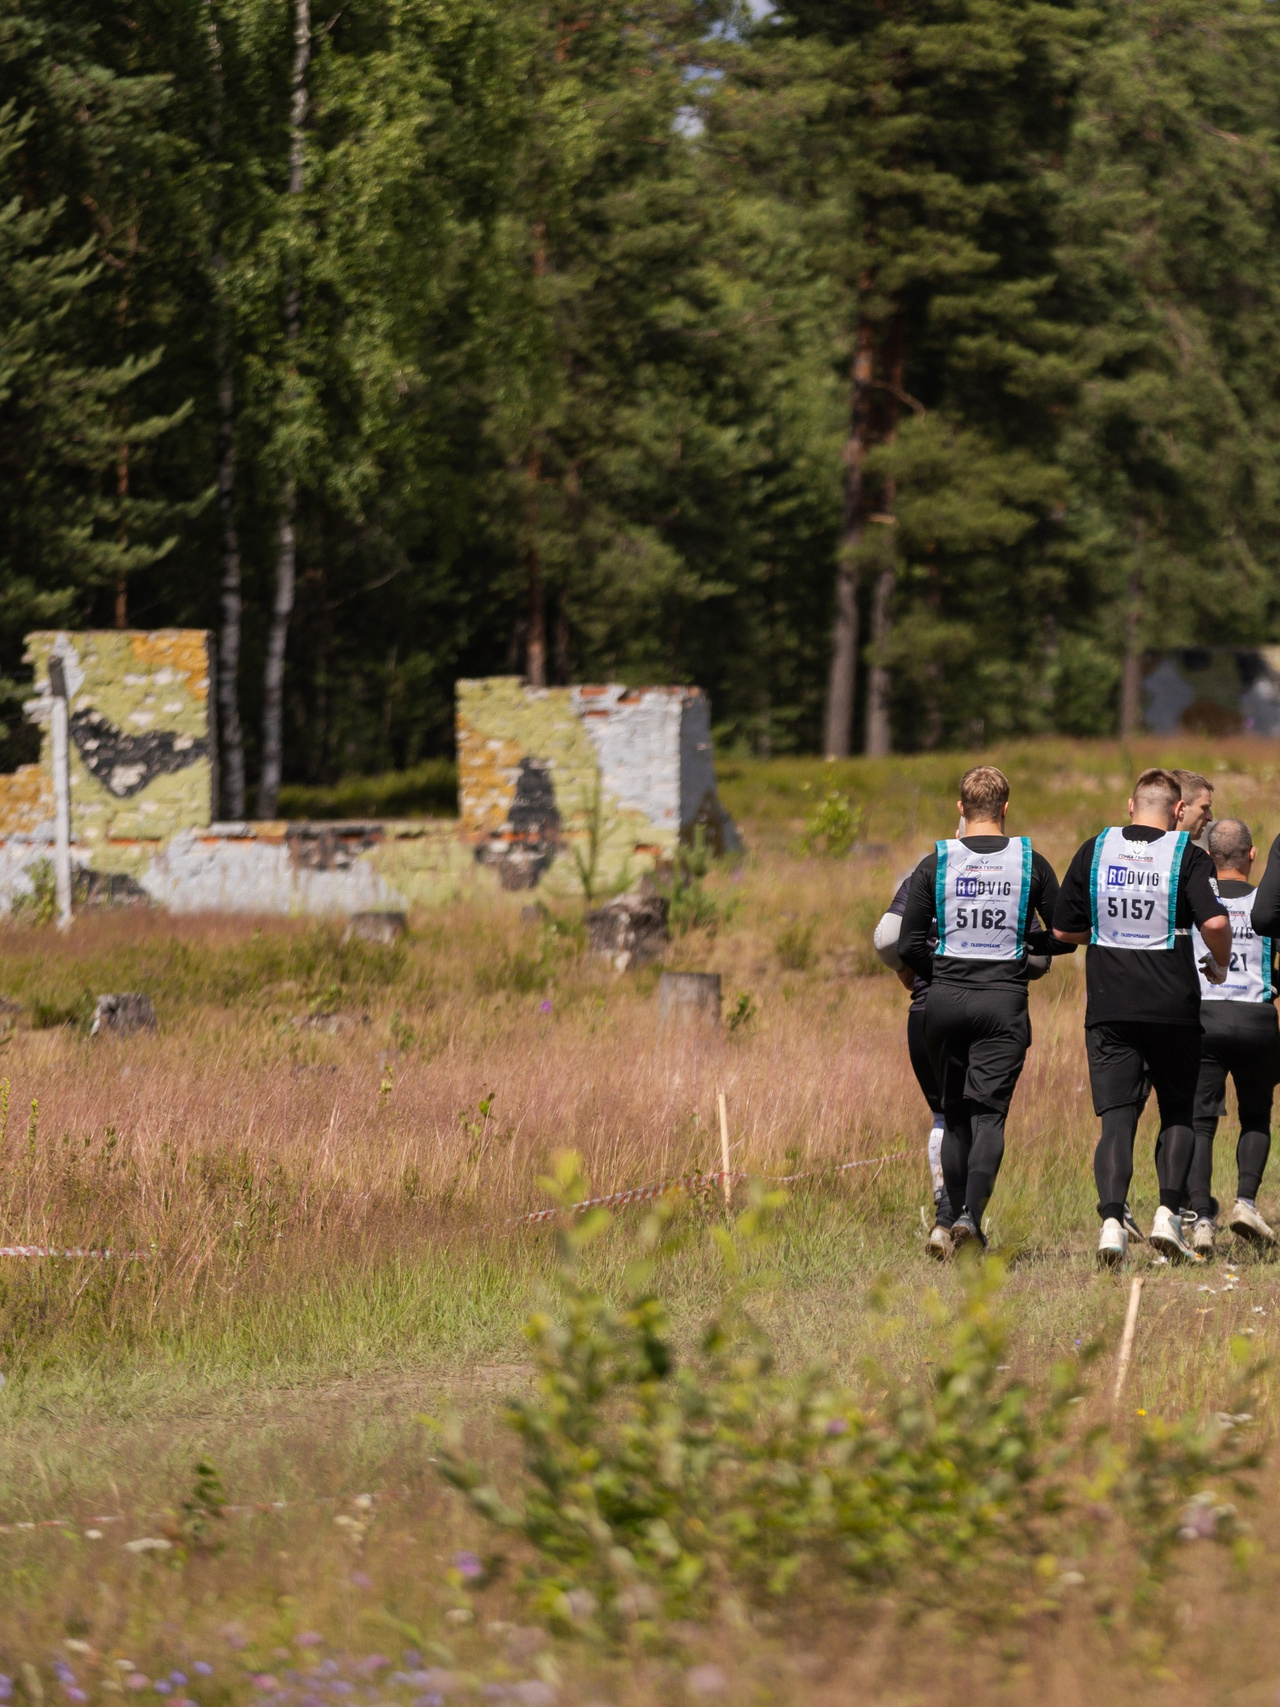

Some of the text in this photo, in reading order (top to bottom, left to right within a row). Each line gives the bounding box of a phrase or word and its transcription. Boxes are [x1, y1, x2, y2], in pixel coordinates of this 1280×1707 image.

[1108, 867, 1159, 887] RODVIG
[957, 879, 1011, 896] RODVIG
[956, 908, 1007, 929] 5162
[1107, 897, 1155, 920] 5157
[1231, 926, 1253, 940] VIG
[1229, 952, 1248, 972] 21
